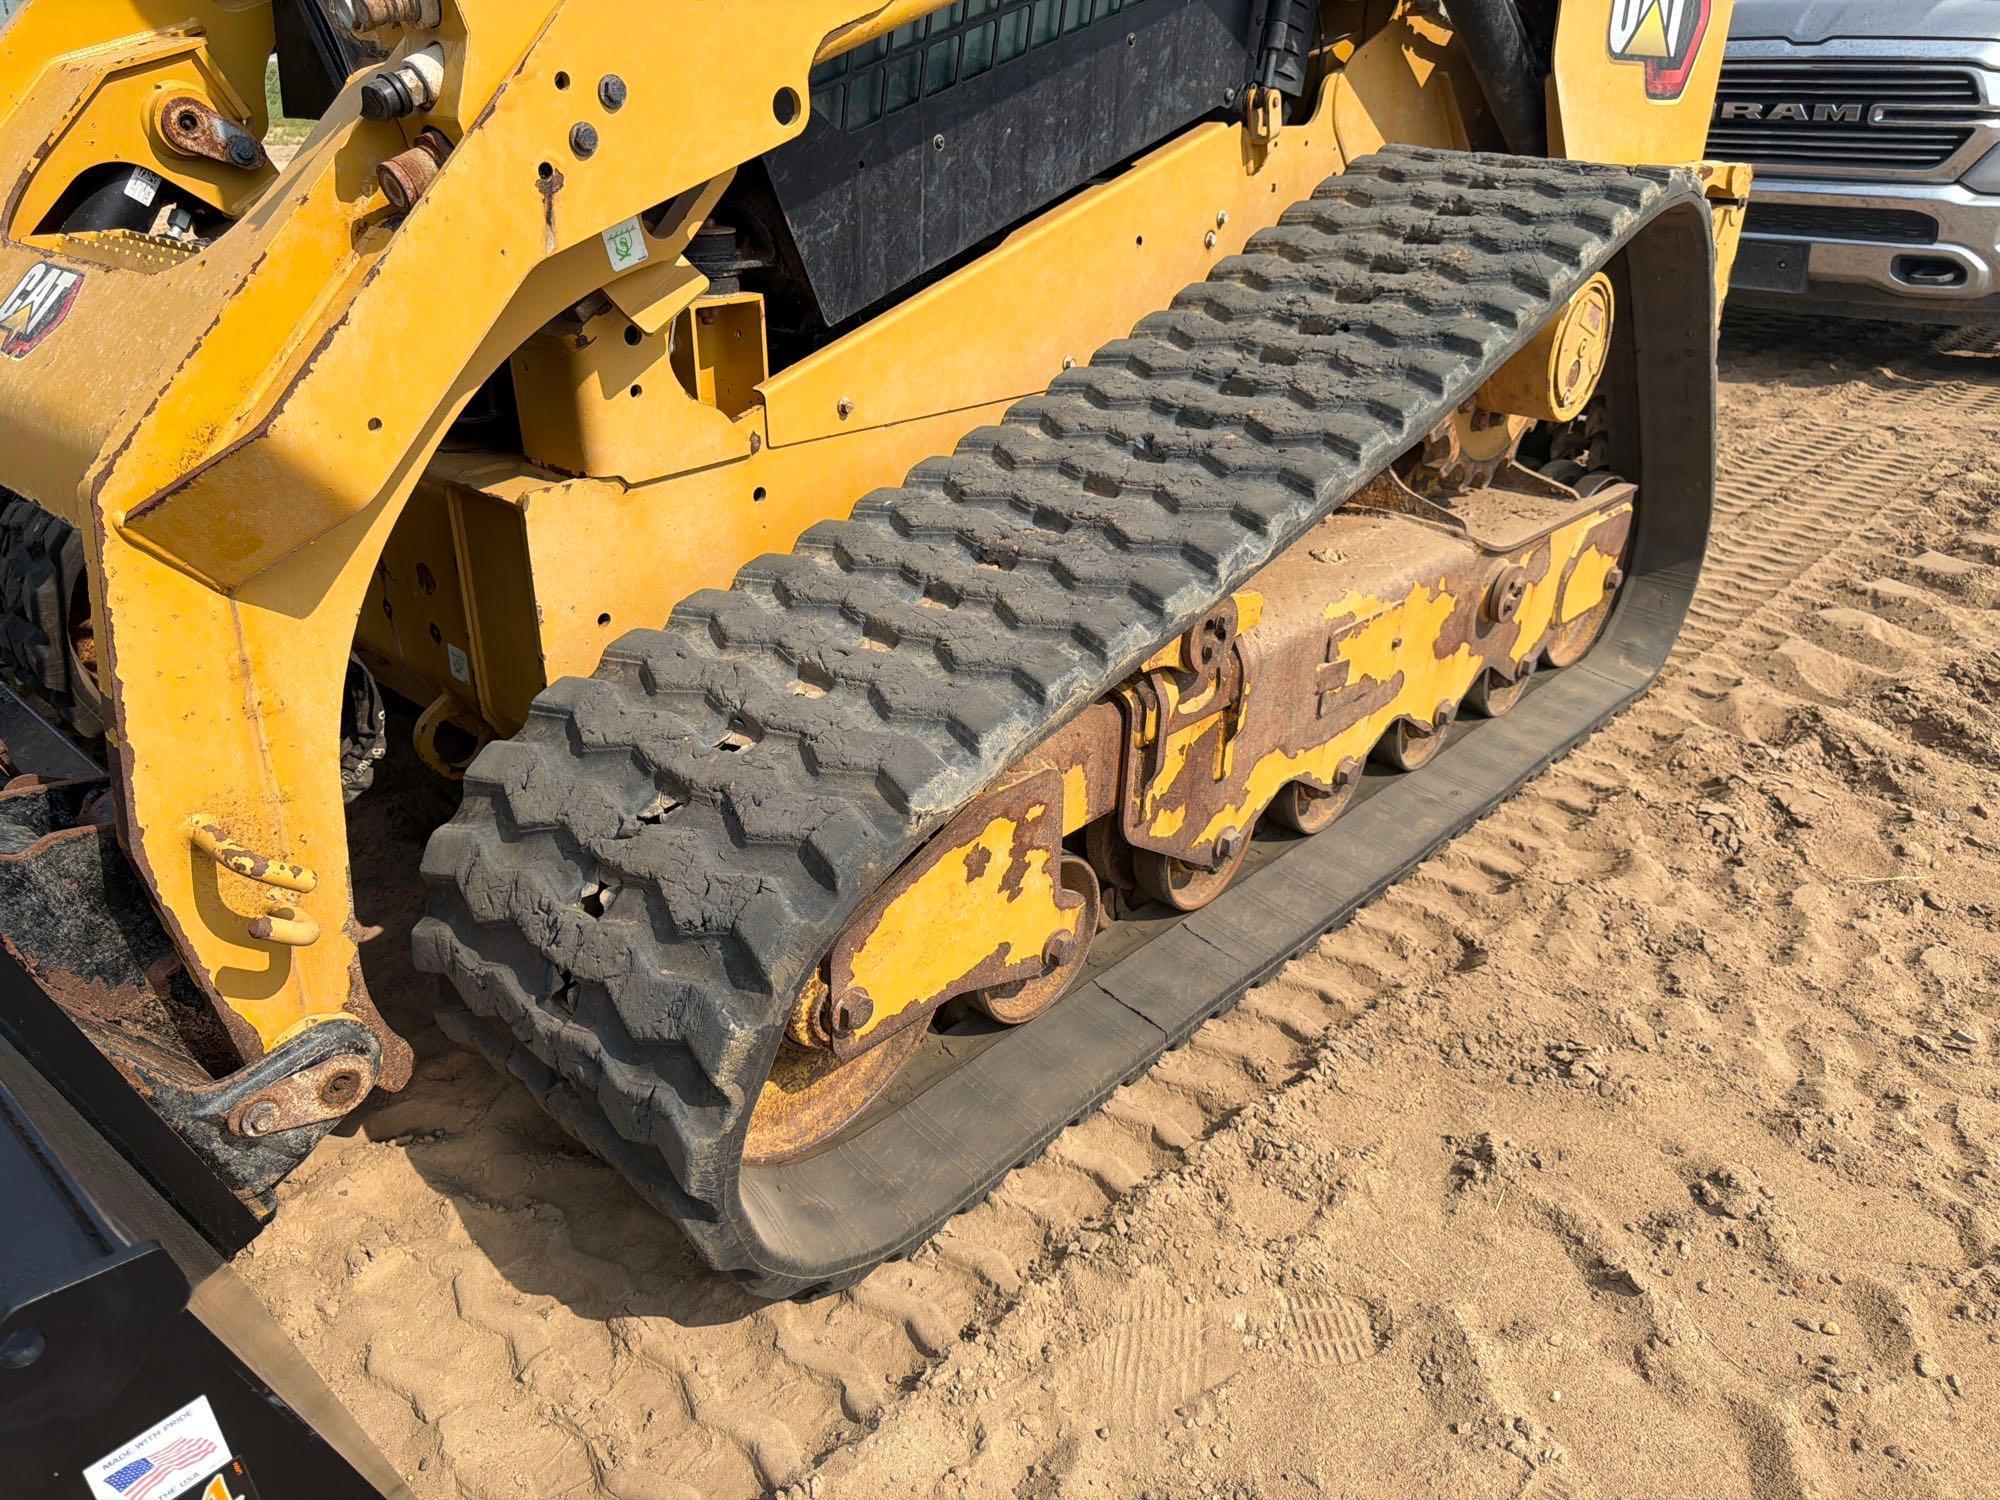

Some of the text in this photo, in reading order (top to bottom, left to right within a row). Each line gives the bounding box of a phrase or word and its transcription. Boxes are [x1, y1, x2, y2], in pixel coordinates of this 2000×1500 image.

[1721, 102, 1863, 122] RAM
[0, 263, 78, 335] CAT
[102, 1410, 192, 1470] MADE WITH PRIDE
[179, 1472, 200, 1487] USA
